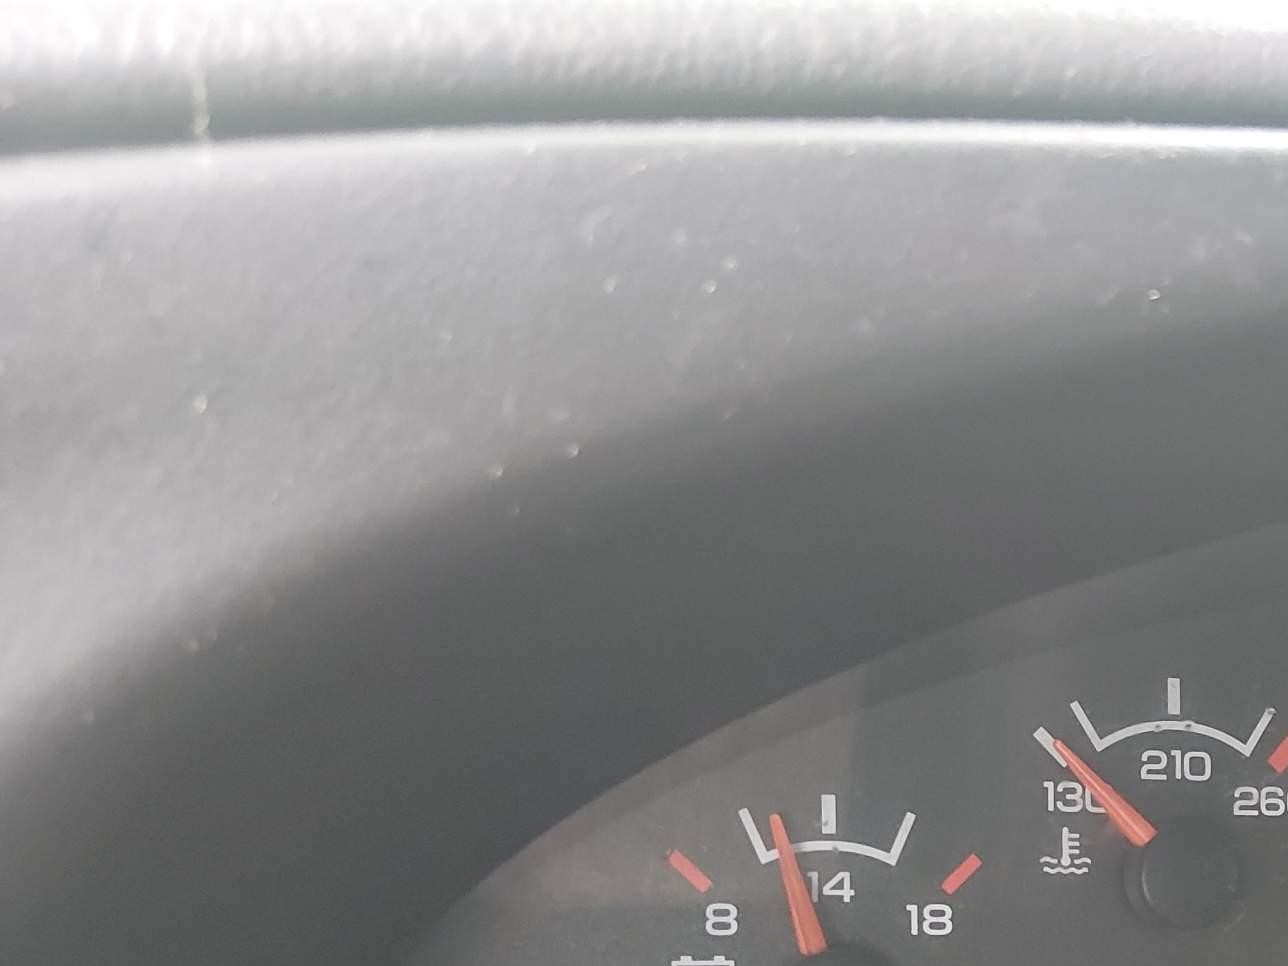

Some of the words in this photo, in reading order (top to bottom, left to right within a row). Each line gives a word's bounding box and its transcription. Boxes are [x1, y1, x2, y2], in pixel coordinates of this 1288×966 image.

[1140, 749, 1212, 782] 210
[807, 871, 855, 902] 14
[705, 903, 738, 936] 8
[906, 903, 953, 936] 18
